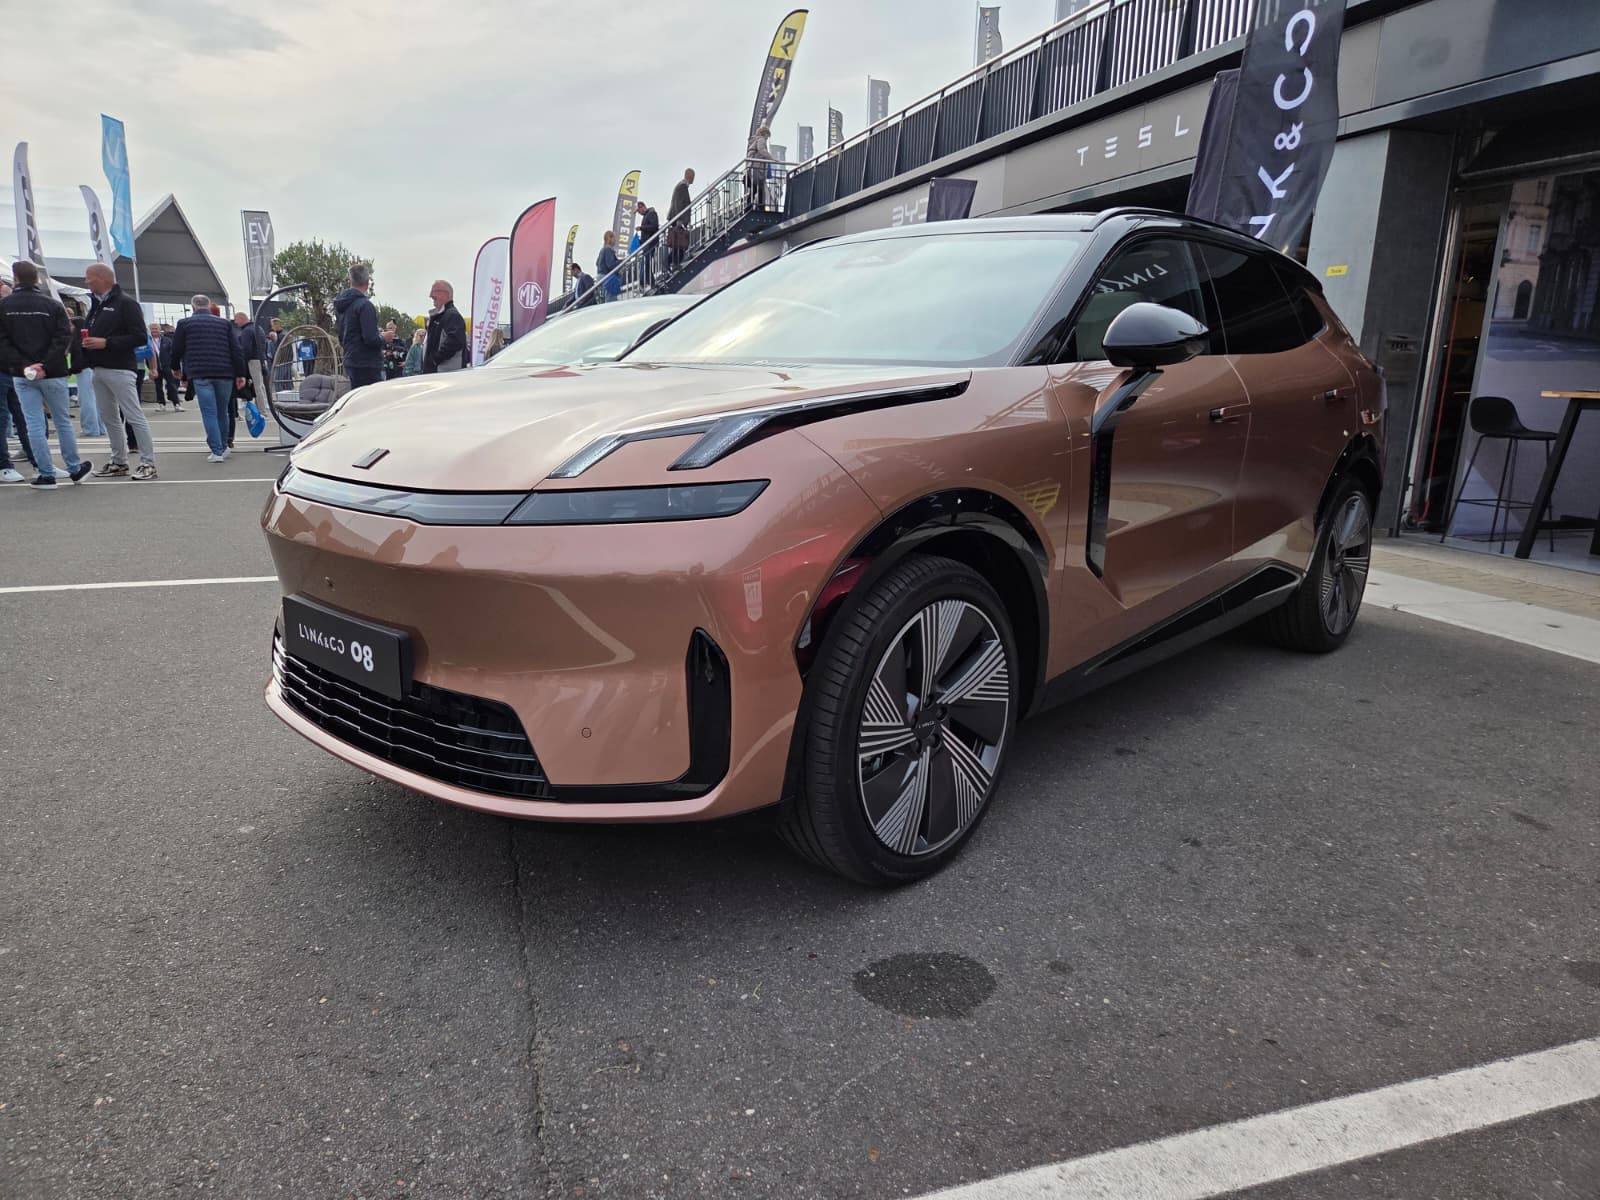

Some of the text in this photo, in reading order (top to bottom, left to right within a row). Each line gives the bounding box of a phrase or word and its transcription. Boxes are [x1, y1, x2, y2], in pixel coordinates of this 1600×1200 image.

[780, 26, 797, 57] EV
[1076, 115, 1190, 167] TESL
[248, 223, 271, 246] EV
[616, 178, 636, 261] EV EXPERIE
[350, 640, 374, 672] 08
